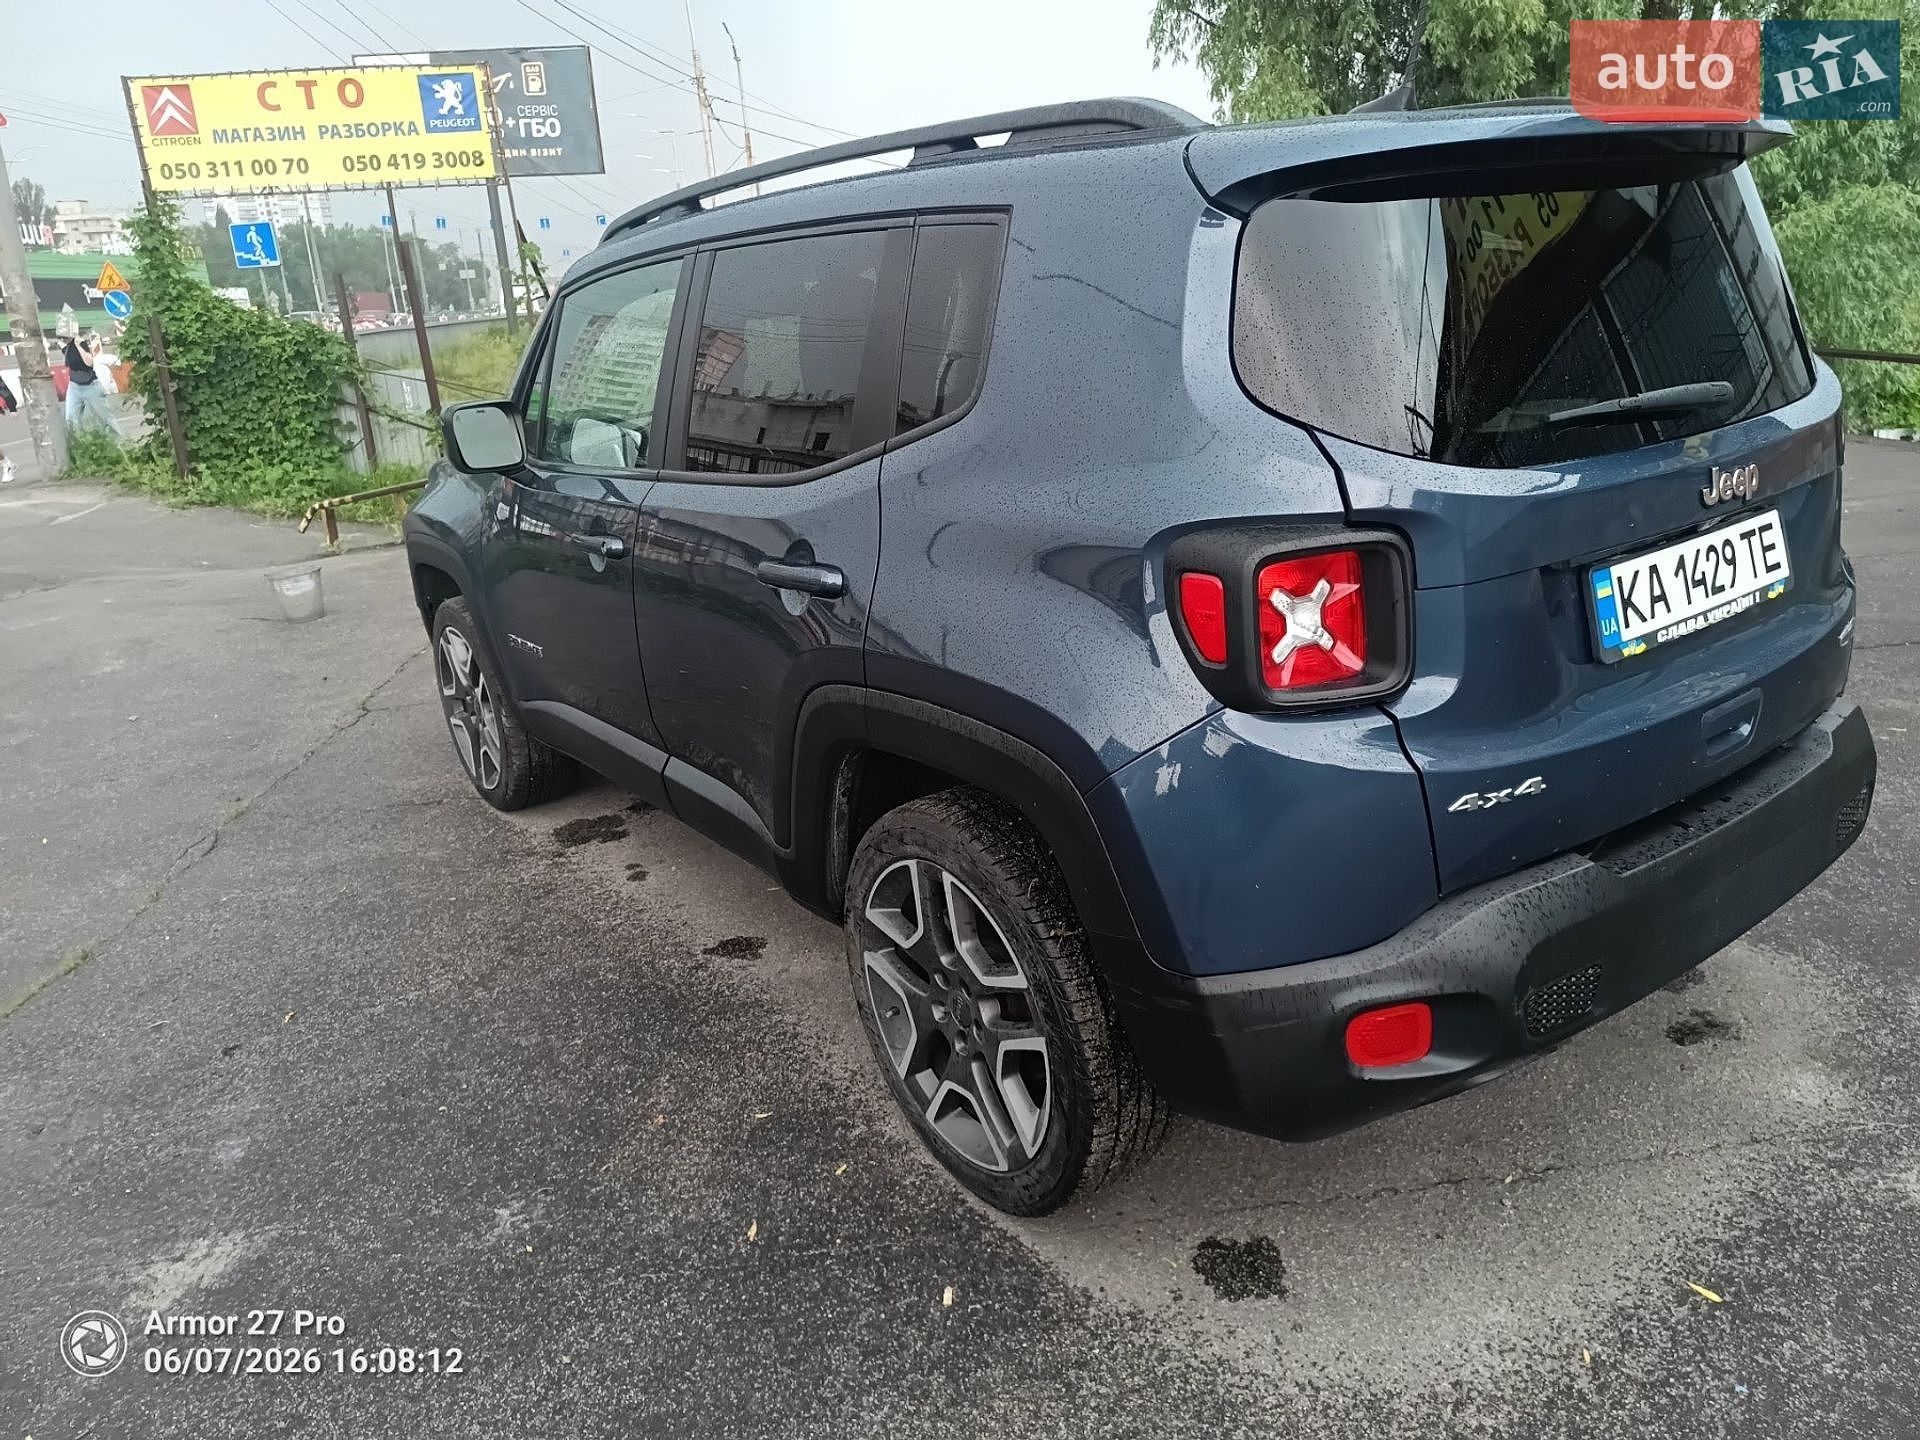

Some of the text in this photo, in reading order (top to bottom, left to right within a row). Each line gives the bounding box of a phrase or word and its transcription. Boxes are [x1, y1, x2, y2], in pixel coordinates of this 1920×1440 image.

[517, 104, 558, 117] СЕРВІС
[212, 121, 420, 144] МАГАЗИН РАЗБОРКА
[430, 117, 475, 128] PEUGEOT
[518, 117, 562, 138] ГБО
[151, 136, 201, 147] CITROEN
[160, 157, 310, 180] 050 311 00 70
[342, 150, 485, 172] 050 419 3008
[1702, 463, 1759, 506] Jeep
[1616, 522, 1782, 629] KA 1429 TE
[1601, 616, 1618, 636] UA
